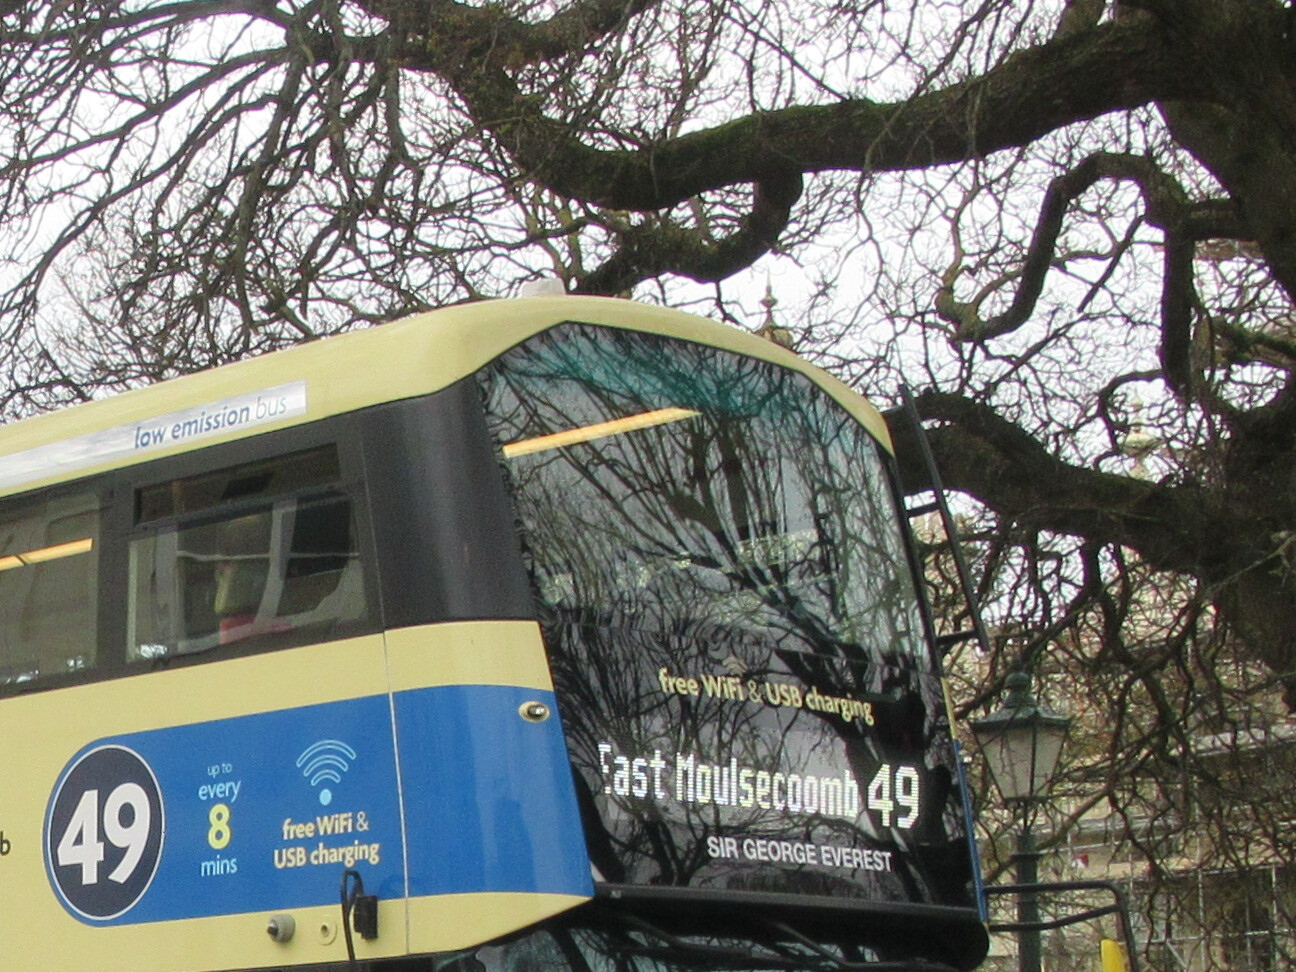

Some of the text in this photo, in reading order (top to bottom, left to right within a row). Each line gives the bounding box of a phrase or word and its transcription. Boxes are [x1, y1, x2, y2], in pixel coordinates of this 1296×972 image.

[135, 396, 287, 449] low emission bus
[659, 667, 875, 726] free WiFi & USB charging
[199, 779, 241, 803] every
[207, 762, 233, 779] up to
[676, 752, 858, 817] Moulsecoomb
[867, 764, 920, 829] 49
[57, 782, 151, 885] 49
[207, 803, 231, 849] 8
[282, 811, 370, 841] free WiFi &
[200, 855, 238, 877] mins
[274, 840, 381, 869] USB charging
[707, 836, 892, 872] SIR GEORGE EVEREST
